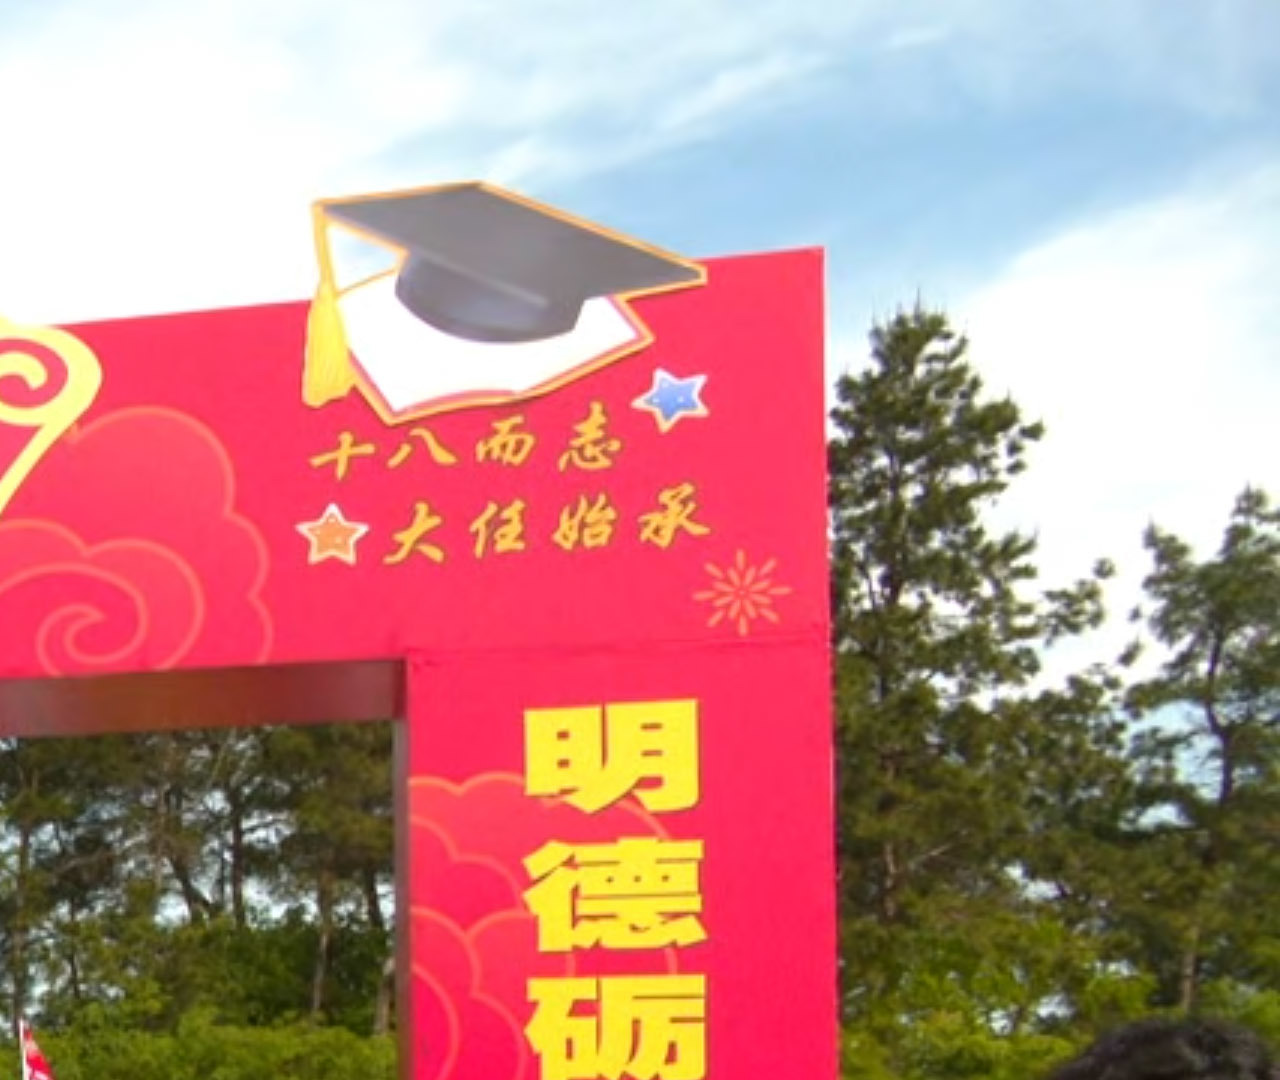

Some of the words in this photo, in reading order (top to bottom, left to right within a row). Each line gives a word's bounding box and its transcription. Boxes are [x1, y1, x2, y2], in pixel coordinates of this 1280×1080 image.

[309, 400, 622, 481] 十八而志
[383, 482, 712, 565] 大任始承
